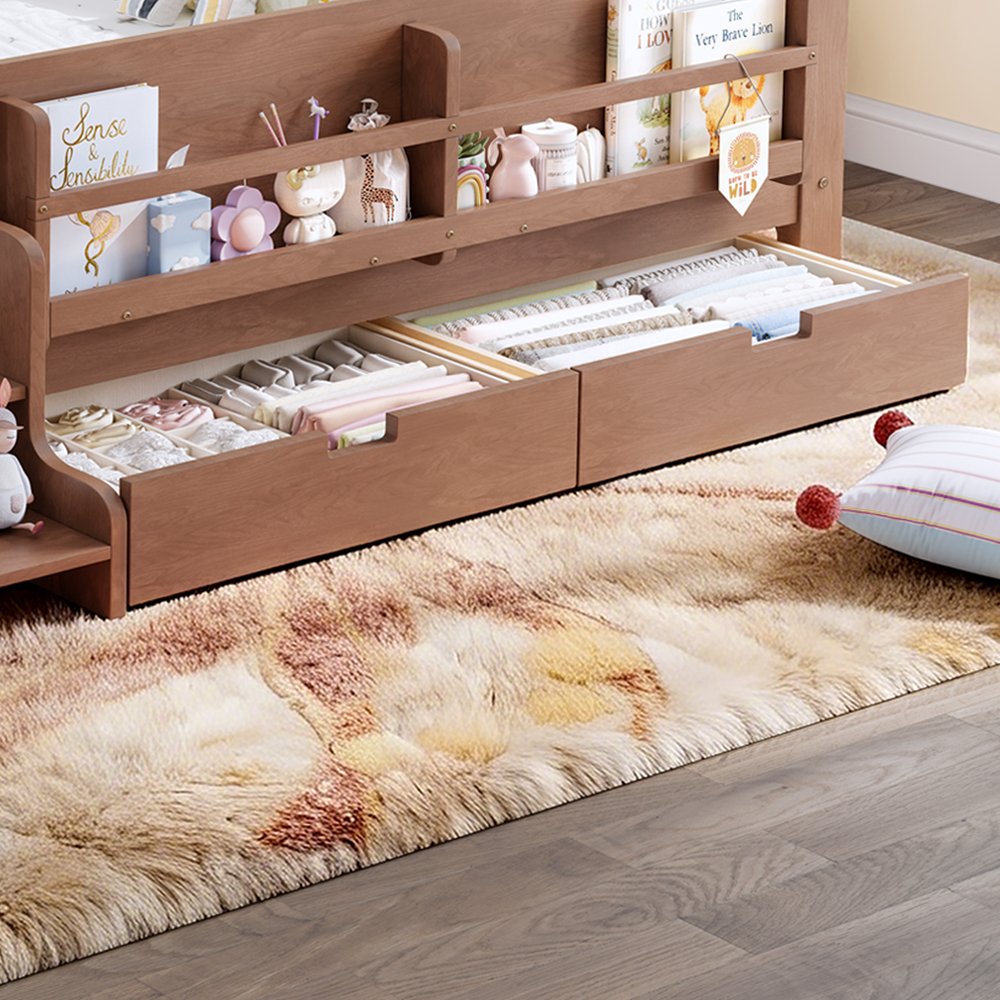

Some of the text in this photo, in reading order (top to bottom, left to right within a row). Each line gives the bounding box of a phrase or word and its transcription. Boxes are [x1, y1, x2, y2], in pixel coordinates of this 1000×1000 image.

[640, 12, 671, 30] HOW
[727, 8, 743, 22] The
[637, 34, 642, 50] I
[695, 22, 773, 49] Very Brave Lion
[62, 102, 127, 146] Sense
[88, 143, 99, 161] &
[50, 146, 139, 191] Sensibility
